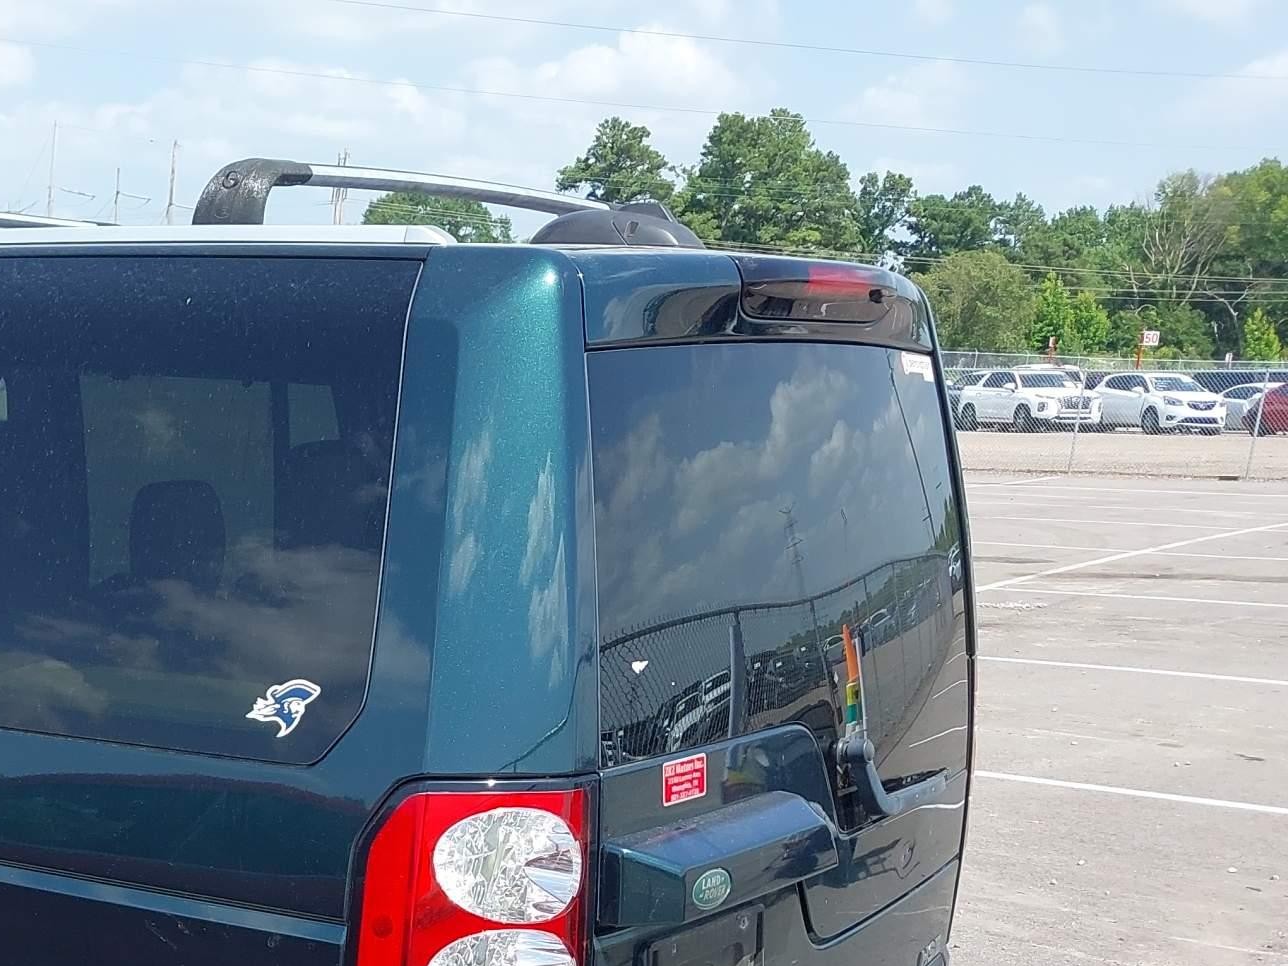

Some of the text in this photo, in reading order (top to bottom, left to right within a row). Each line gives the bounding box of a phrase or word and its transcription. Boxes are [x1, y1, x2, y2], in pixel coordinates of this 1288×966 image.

[1144, 332, 1159, 344] 50
[702, 874, 721, 890] LAND
[703, 883, 726, 901] ROVER
